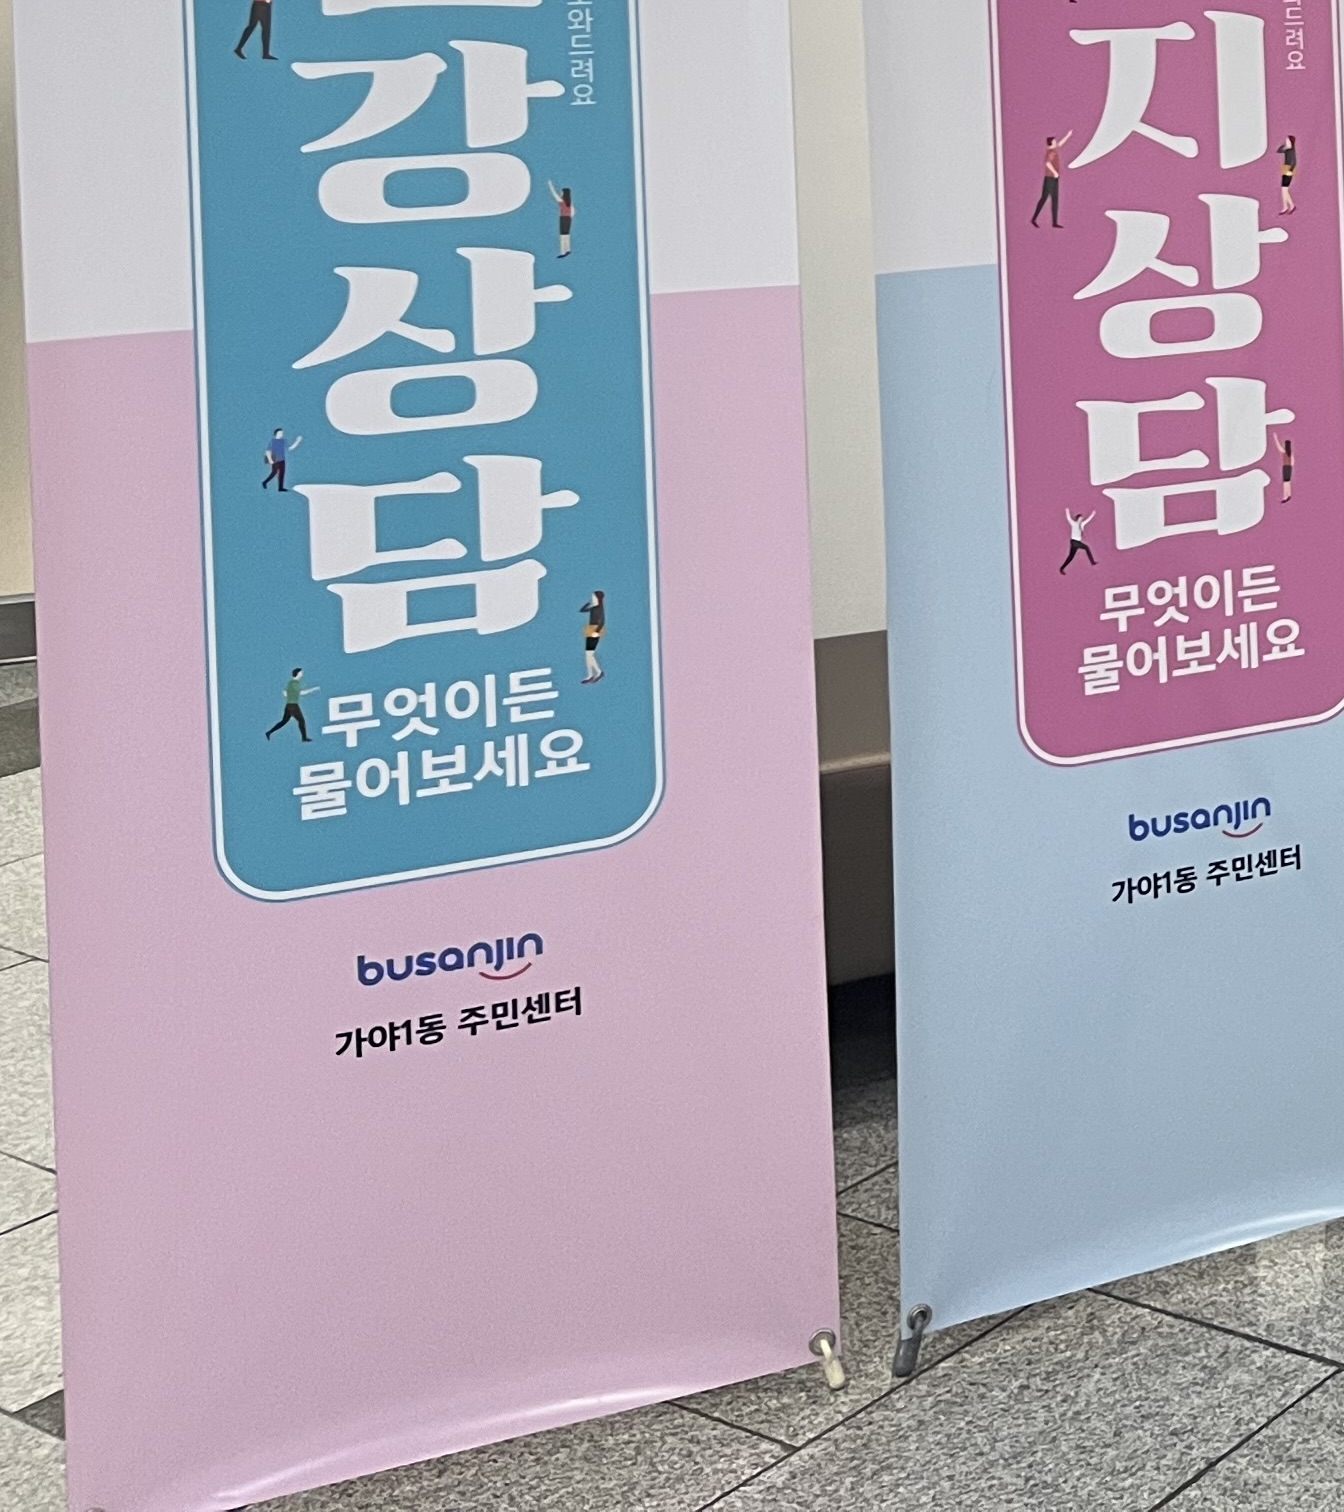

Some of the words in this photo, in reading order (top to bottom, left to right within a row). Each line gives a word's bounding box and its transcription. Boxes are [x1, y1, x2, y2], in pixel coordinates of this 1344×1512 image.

[1100, 563, 1281, 633] 무엇이든
[1077, 617, 1306, 696] 물어보세요
[320, 667, 560, 749] 무엇이든
[291, 728, 591, 822] 물어보세요
[1128, 796, 1272, 842] busanjin
[1111, 867, 1198, 904] 가야1동
[1205, 843, 1303, 888] 주민센터
[356, 932, 545, 987] busanjin
[334, 1012, 447, 1060] 가야1동
[457, 986, 585, 1037] 주민센터
